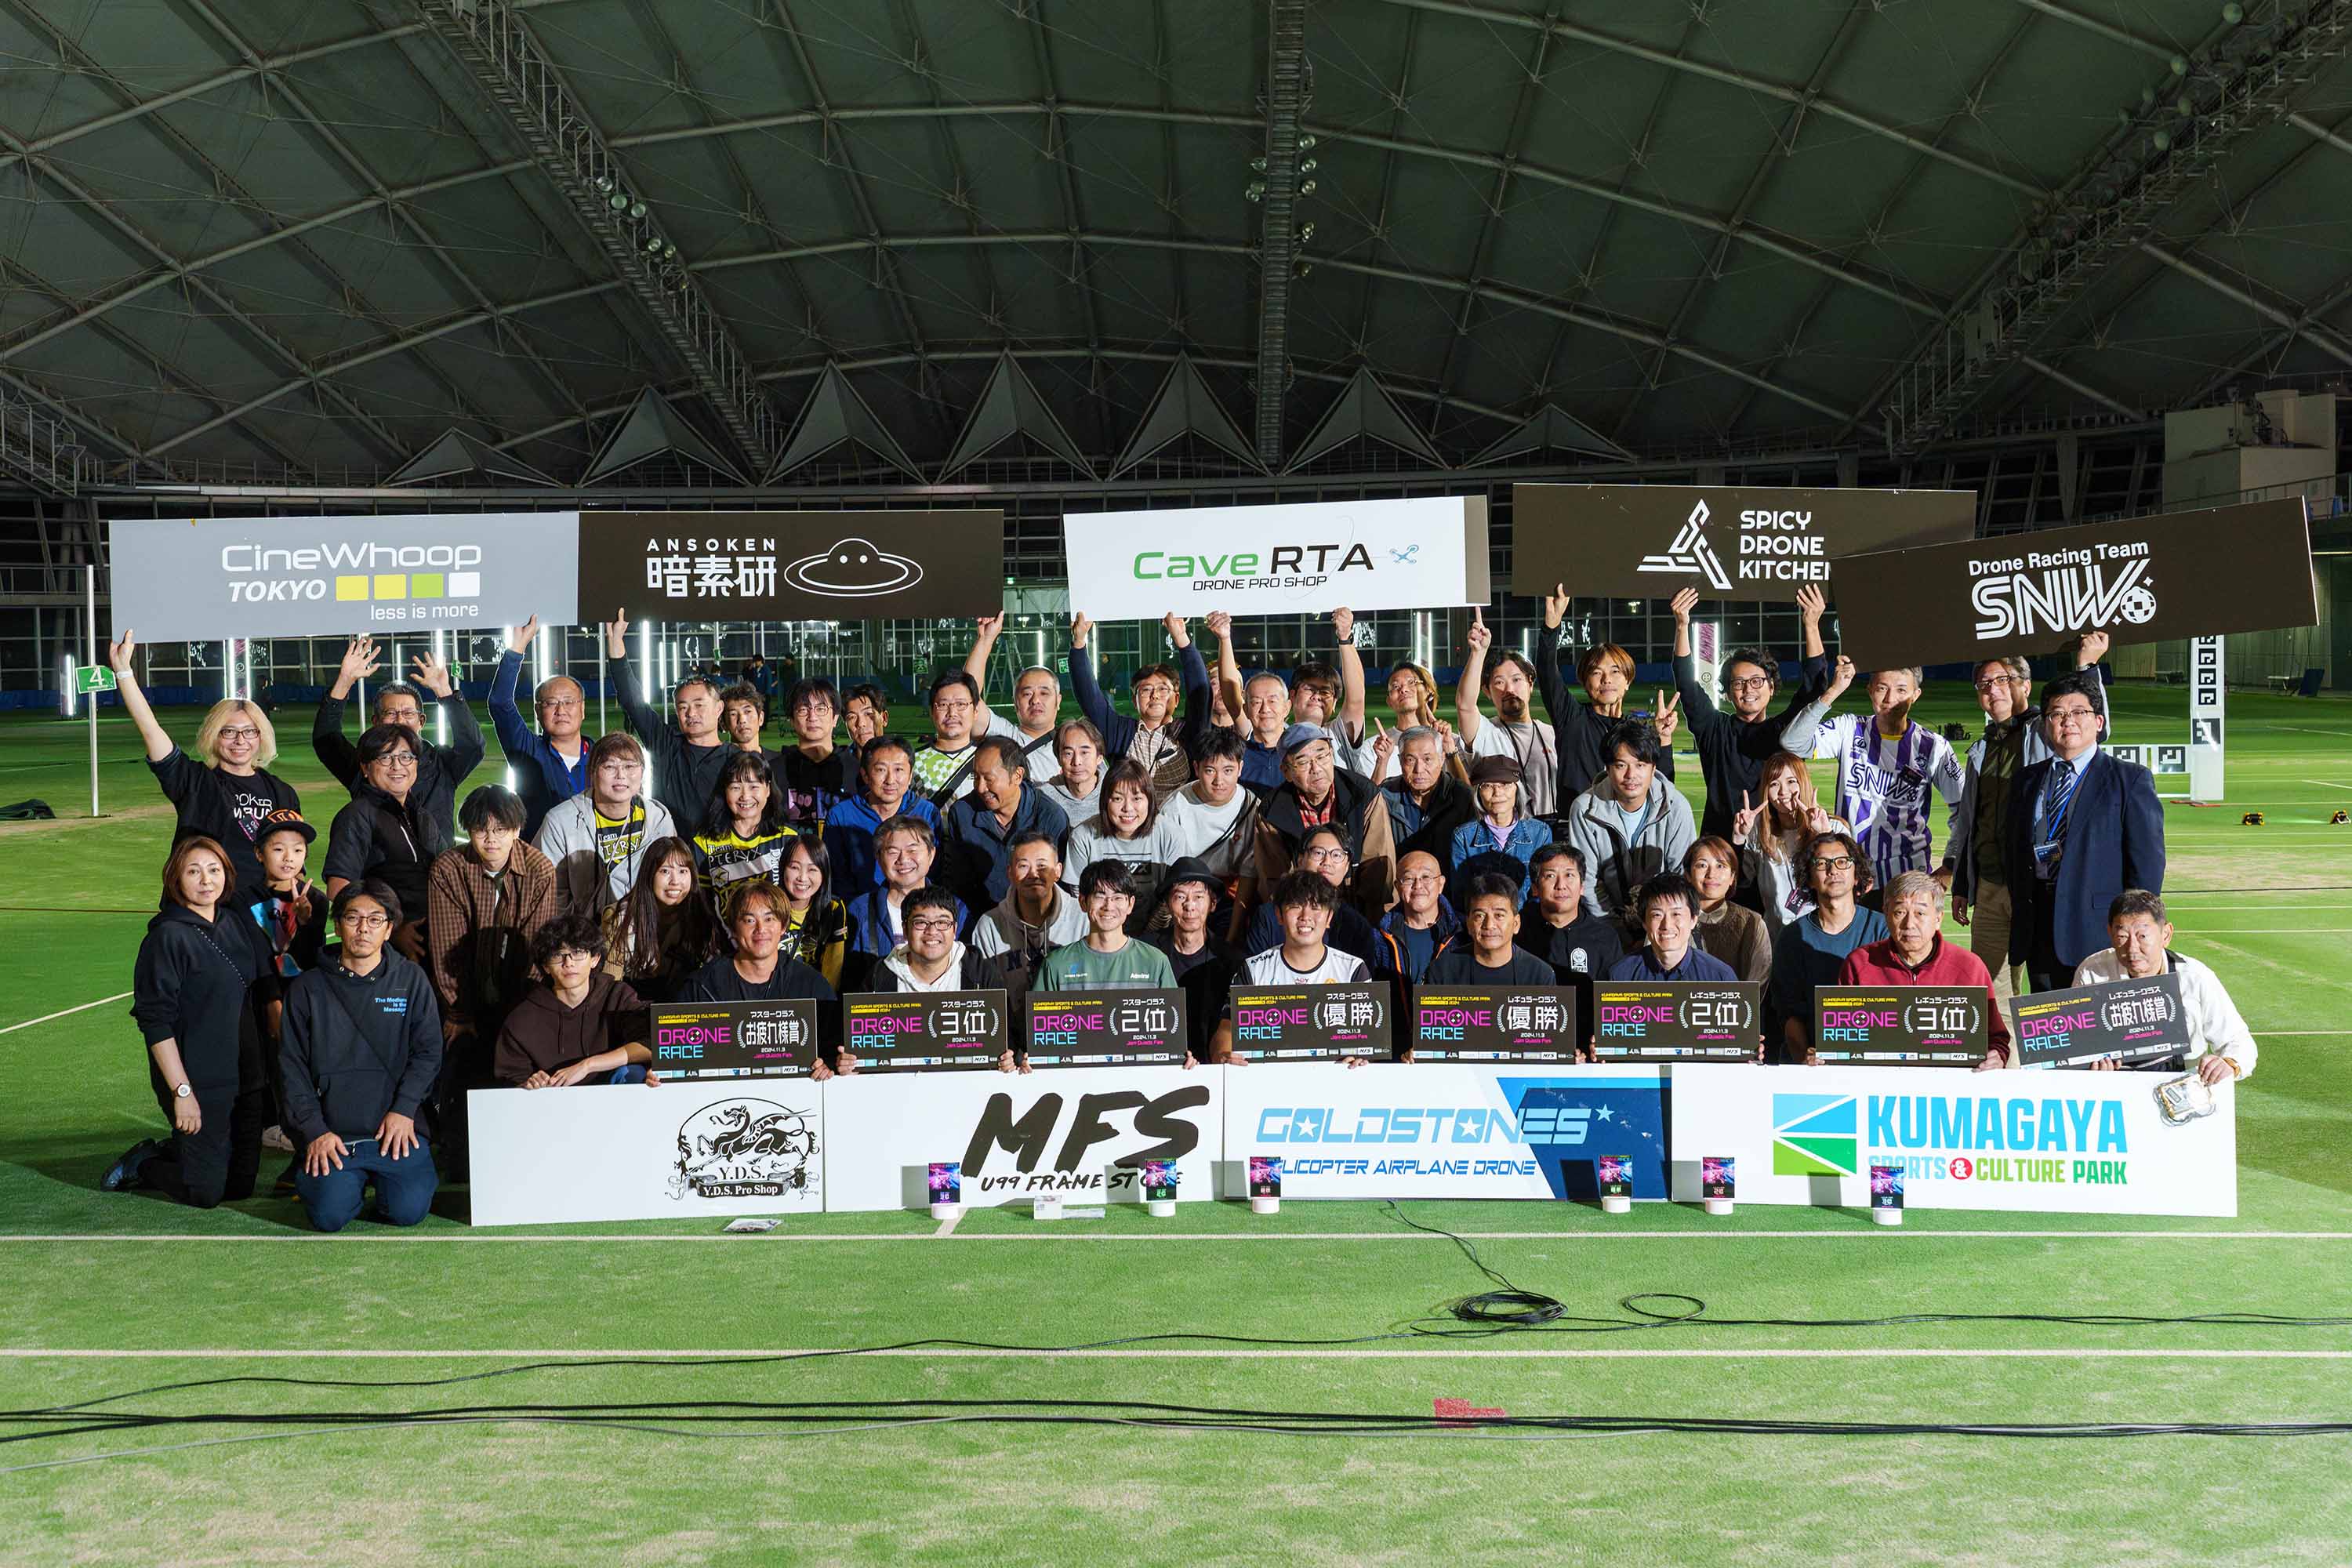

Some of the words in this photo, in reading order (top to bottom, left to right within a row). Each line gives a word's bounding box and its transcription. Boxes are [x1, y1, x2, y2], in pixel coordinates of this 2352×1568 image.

[1740, 510, 1812, 531] SPICY
[647, 538, 776, 552] ANSOKEN
[1740, 535, 1824, 556] DRONE
[222, 542, 481, 572] CineWhoop
[1134, 550, 1258, 580] Cave
[1270, 543, 1374, 575] RTA
[1968, 557, 2024, 577] Drone
[2027, 548, 2092, 571] Racing
[2094, 540, 2149, 561] Team
[646, 555, 777, 597] 暗素研
[1192, 578, 1245, 591] DRONE
[1249, 577, 1280, 590] PRO
[1283, 575, 1327, 589] SHOP
[228, 579, 326, 602] TOKYO
[370, 604, 406, 620] less
[412, 604, 426, 619] is
[432, 604, 478, 619] more
[89, 666, 105, 687] 4
[708, 844, 733, 855] Team
[708, 847, 761, 868] PTERYX
[2108, 985, 2161, 1000] レギュラークラス
[1121, 1008, 1167, 1033] 2位
[1237, 1007, 1308, 1026] DRONE
[1323, 1003, 1373, 1027] 優勝
[1420, 1008, 1491, 1026] DRONE
[1507, 1006, 1559, 1030] 優勝
[1600, 1005, 1673, 1023] DRONE
[1692, 1002, 1740, 1026] 2位
[1822, 1010, 1897, 1028] DRONE
[1917, 1007, 1966, 1031] 3位
[2109, 996, 2168, 1027] お疲れ様賞
[850, 1015, 922, 1035] DRONE
[941, 1011, 987, 1035] 3位
[1033, 1013, 1104, 1032] DRONE
[1238, 1025, 1282, 1040] RACE
[1601, 1022, 1646, 1036] RACE
[2019, 1010, 2097, 1039] DRONE
[658, 1025, 731, 1046] DRONE
[746, 1021, 800, 1045] お疲れ様賞
[851, 1033, 895, 1048] RACE
[1033, 1031, 1077, 1045] RACE
[1420, 1026, 1464, 1040] RACE
[1823, 1028, 1869, 1041] RACE
[2023, 1032, 2071, 1052] RACE
[658, 1044, 704, 1059] RACE
[960, 1085, 1210, 1177] MFS
[1867, 1094, 2129, 1153] KUMAGAYA
[718, 1167, 765, 1180] Y.D.S.
[1373, 1159, 1468, 1175] AIRPLANE
[1473, 1160, 1537, 1176] DRONE
[1950, 1160, 1969, 1178] &
[1976, 1159, 2066, 1183] CULTURE
[2073, 1160, 2128, 1185] PARK
[703, 1185, 733, 1196] Y.D.S.
[735, 1184, 752, 1196] Pro
[754, 1184, 779, 1196] Shop
[981, 1174, 1021, 1192] U99
[1025, 1174, 1103, 1192] FRAME
